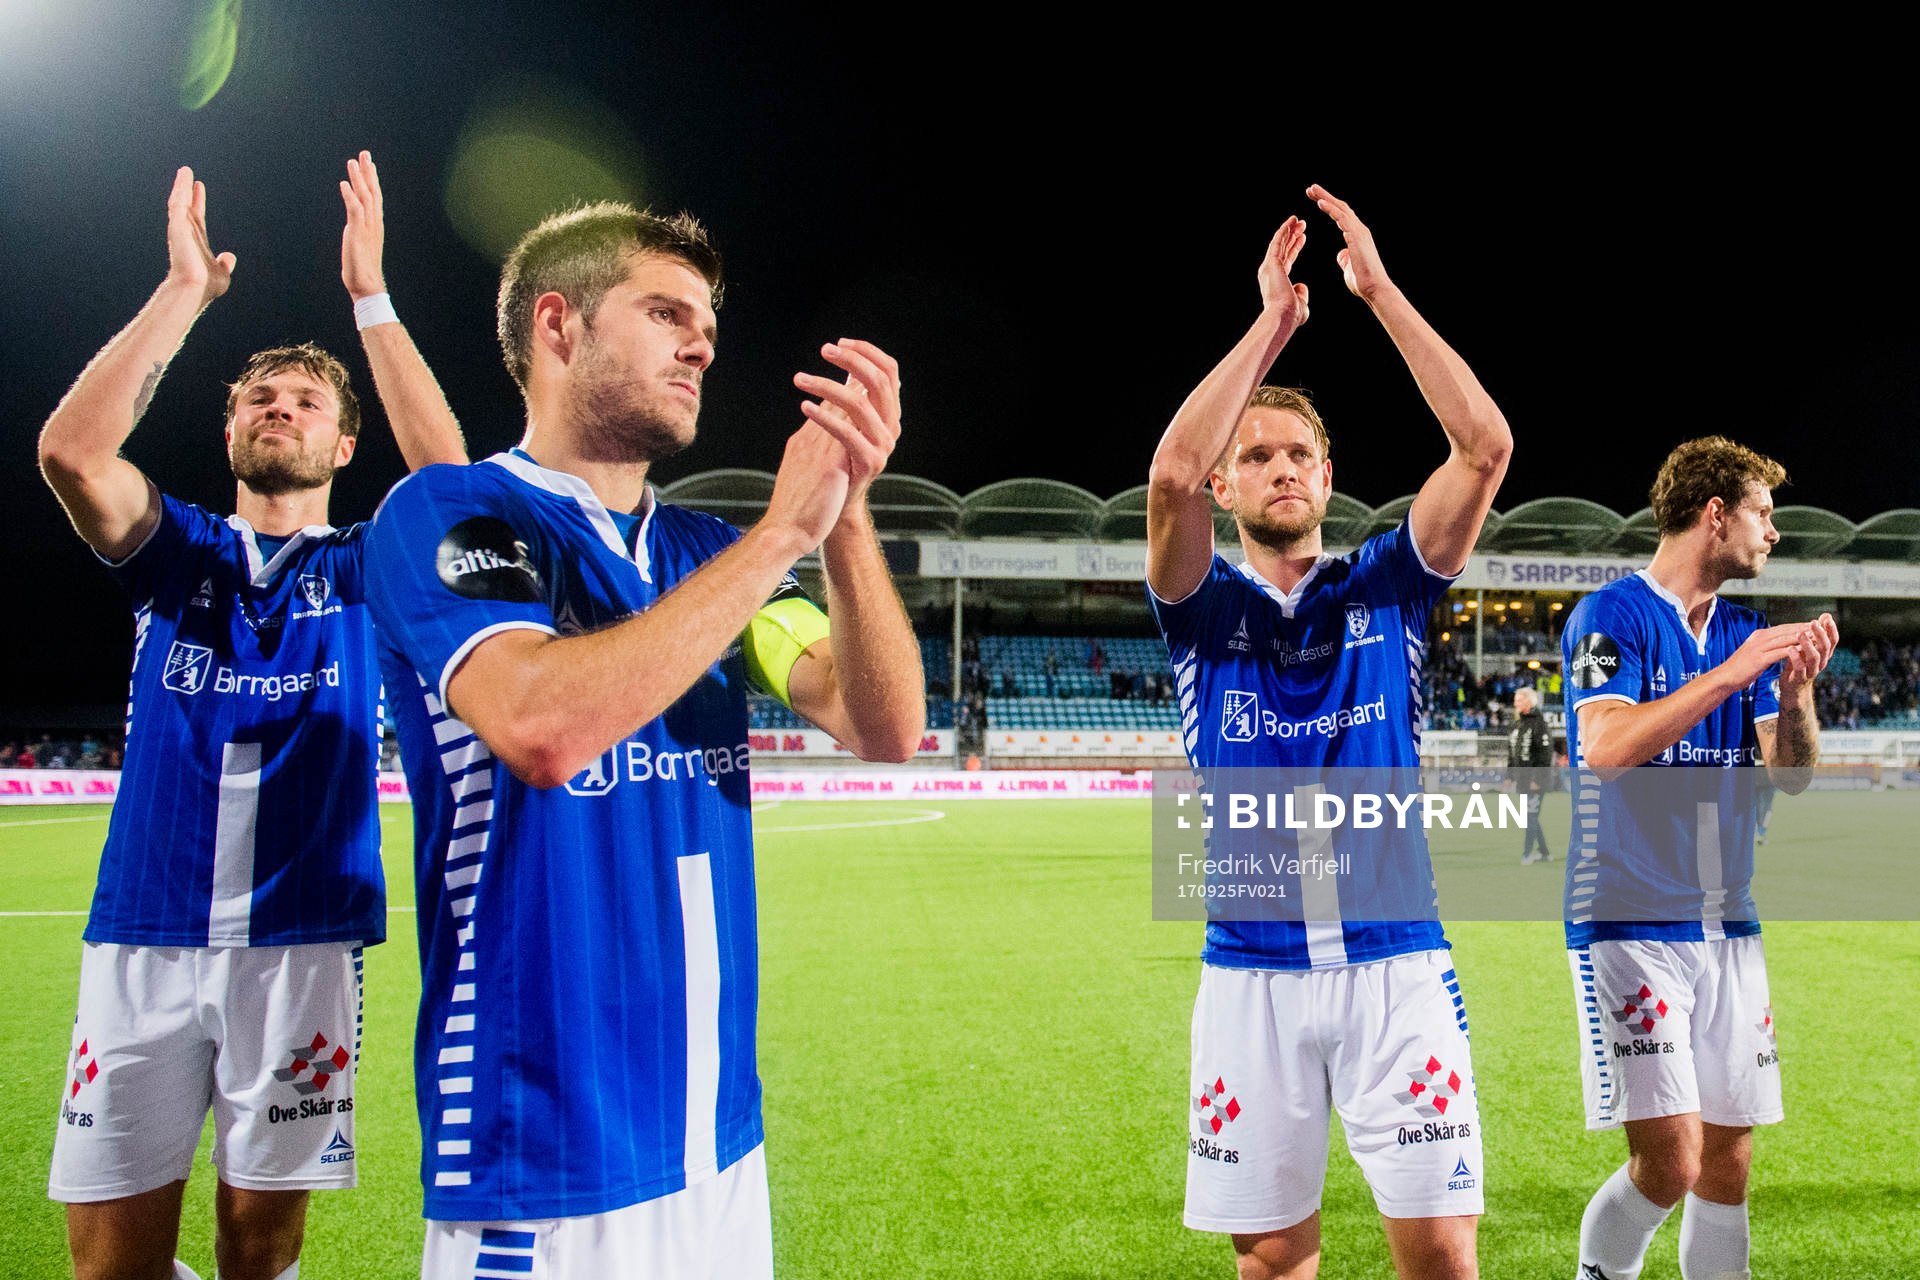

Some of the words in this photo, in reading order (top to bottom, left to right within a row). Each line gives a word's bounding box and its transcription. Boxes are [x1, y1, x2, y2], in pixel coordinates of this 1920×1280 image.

[1572, 653, 1617, 671] altibox
[1261, 694, 1387, 739] Borregaard
[627, 741, 749, 787] Borrgaa
[1613, 1042, 1632, 1058] Ove
[1632, 1039, 1660, 1056] Skår
[1662, 1041, 1674, 1054] as
[79, 1112, 94, 1127] as
[268, 1104, 298, 1124] Ove
[299, 1096, 335, 1119] Skår
[336, 1097, 354, 1113] as
[1398, 1126, 1423, 1146] Ove
[1423, 1121, 1456, 1142] Skår
[1458, 1123, 1471, 1138] as
[320, 1151, 355, 1164] SELECT
[1197, 1137, 1223, 1161] Skår
[1223, 1149, 1239, 1164] as
[1447, 1179, 1475, 1191] SELECT
